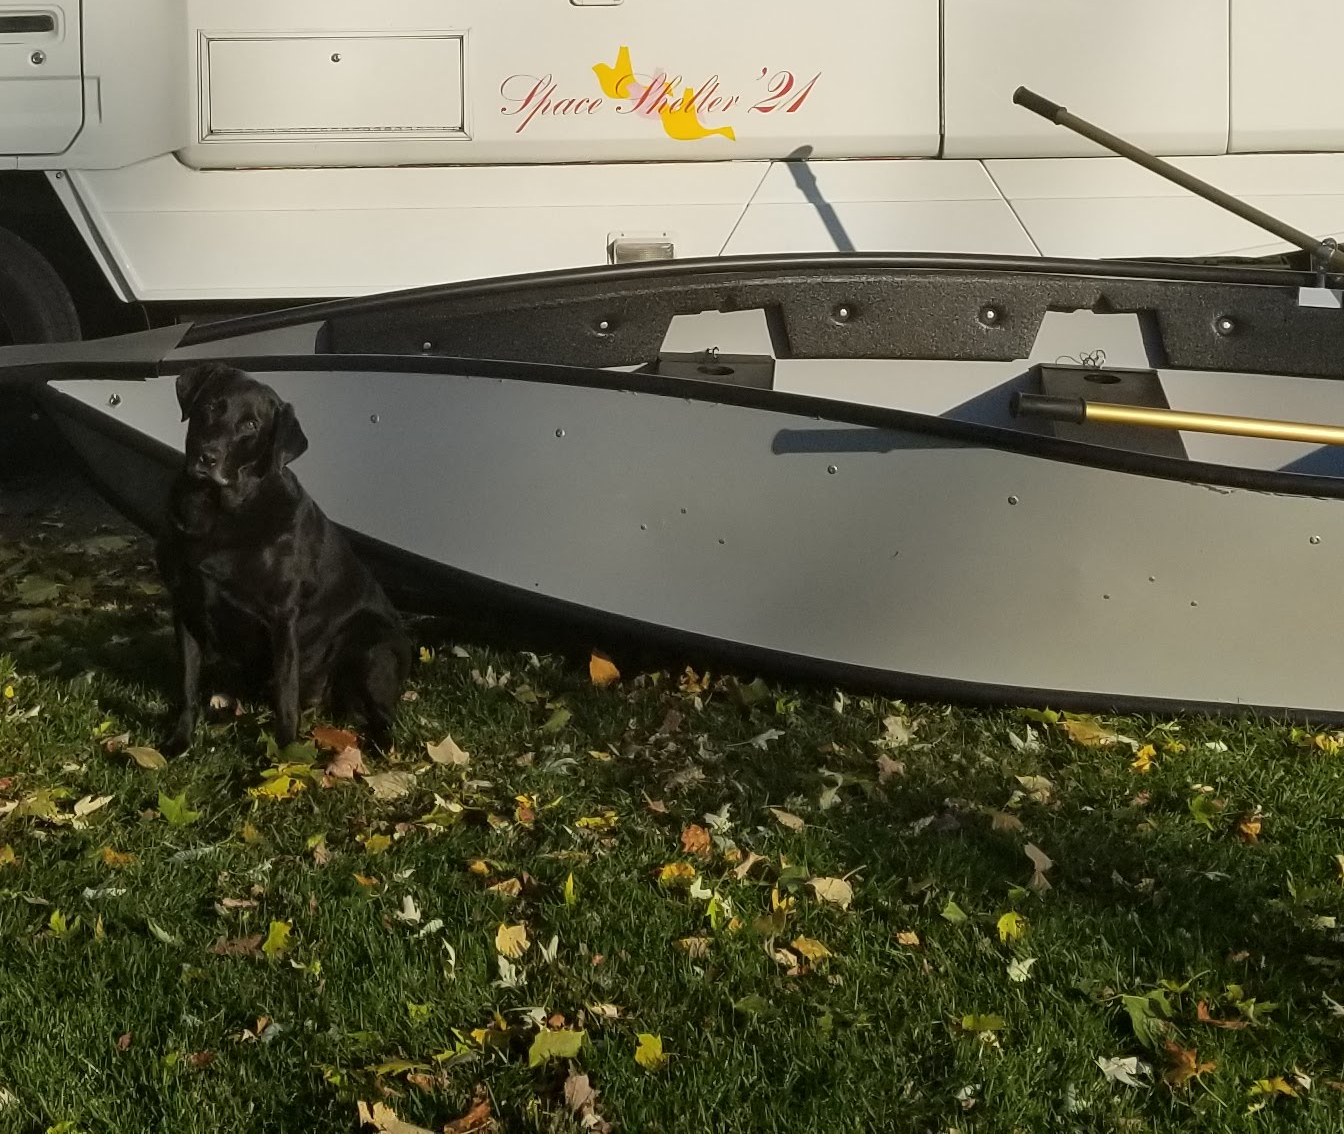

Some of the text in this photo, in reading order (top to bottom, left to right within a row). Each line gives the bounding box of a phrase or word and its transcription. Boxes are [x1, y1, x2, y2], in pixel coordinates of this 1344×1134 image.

[500, 67, 823, 134] Space Shelter '21
